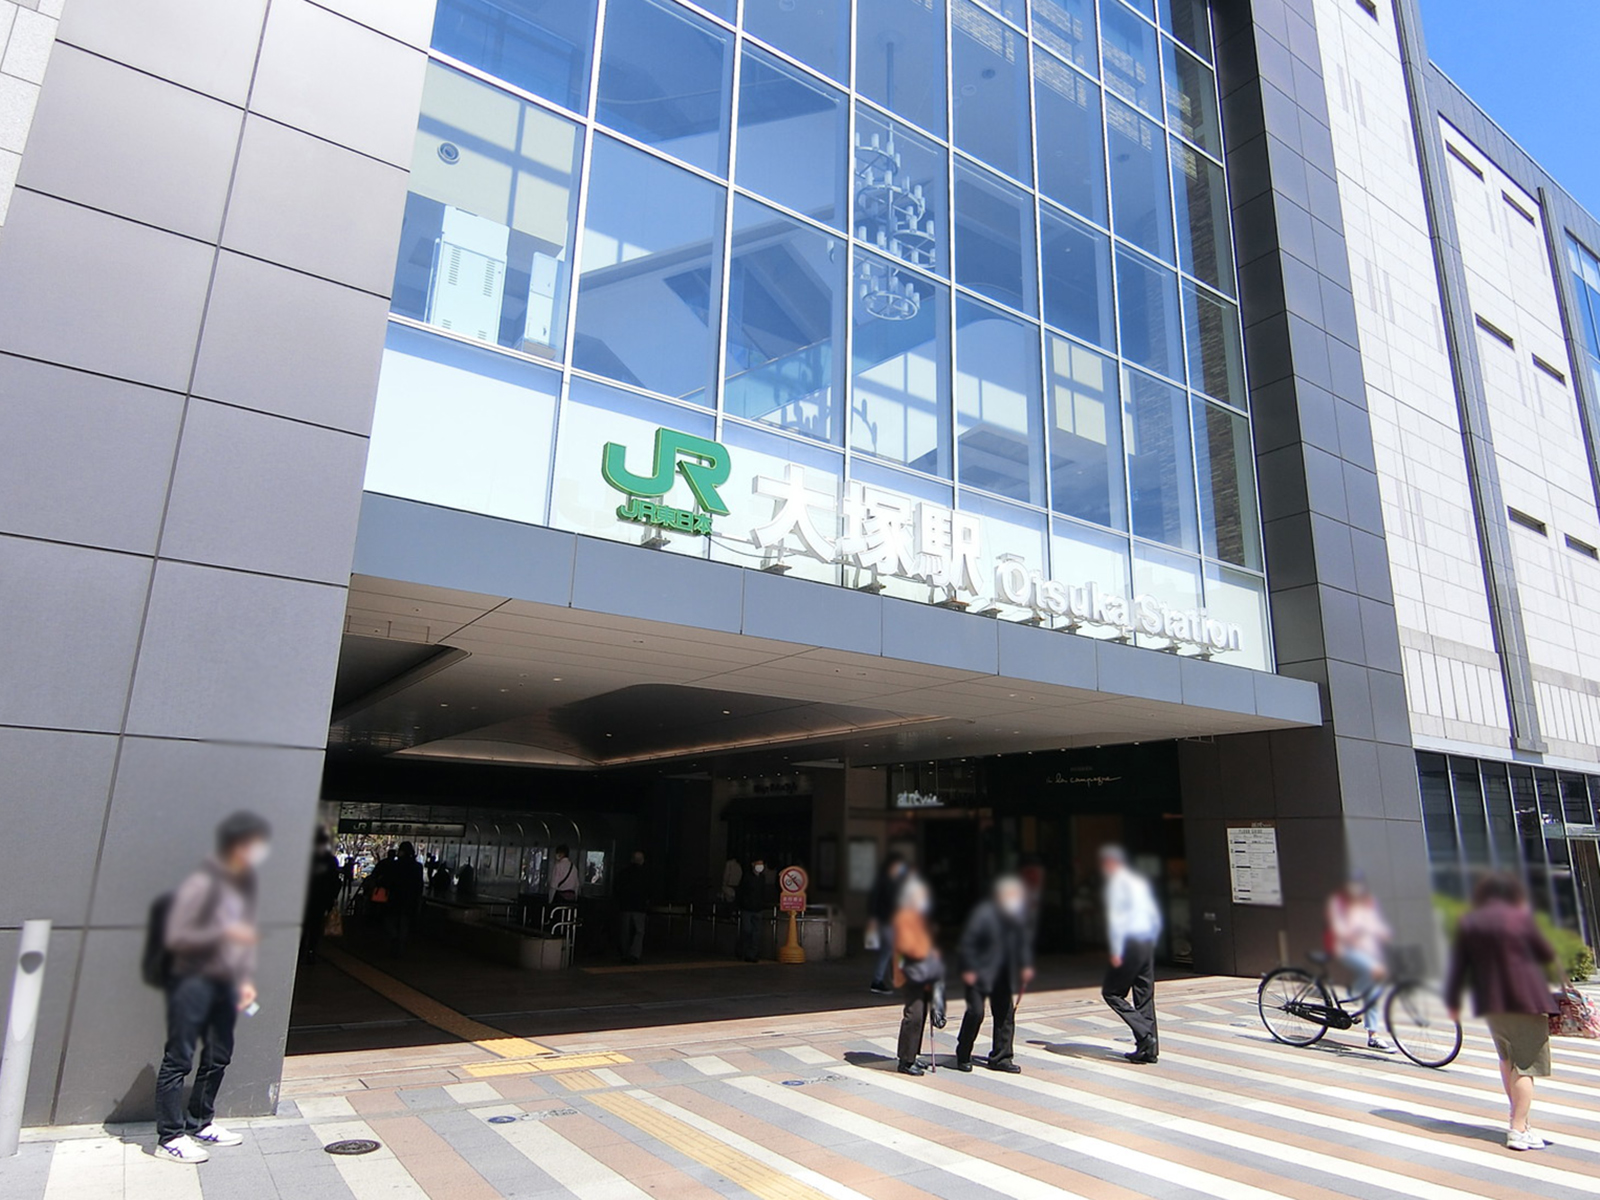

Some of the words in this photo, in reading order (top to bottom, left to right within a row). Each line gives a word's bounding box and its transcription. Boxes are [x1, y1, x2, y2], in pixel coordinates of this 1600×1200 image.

[601, 427, 731, 517] JR
[616, 498, 713, 537] JR東日本
[749, 463, 984, 597] 大塚駅
[1134, 594, 1244, 650] Station
[353, 822, 367, 830] JR
